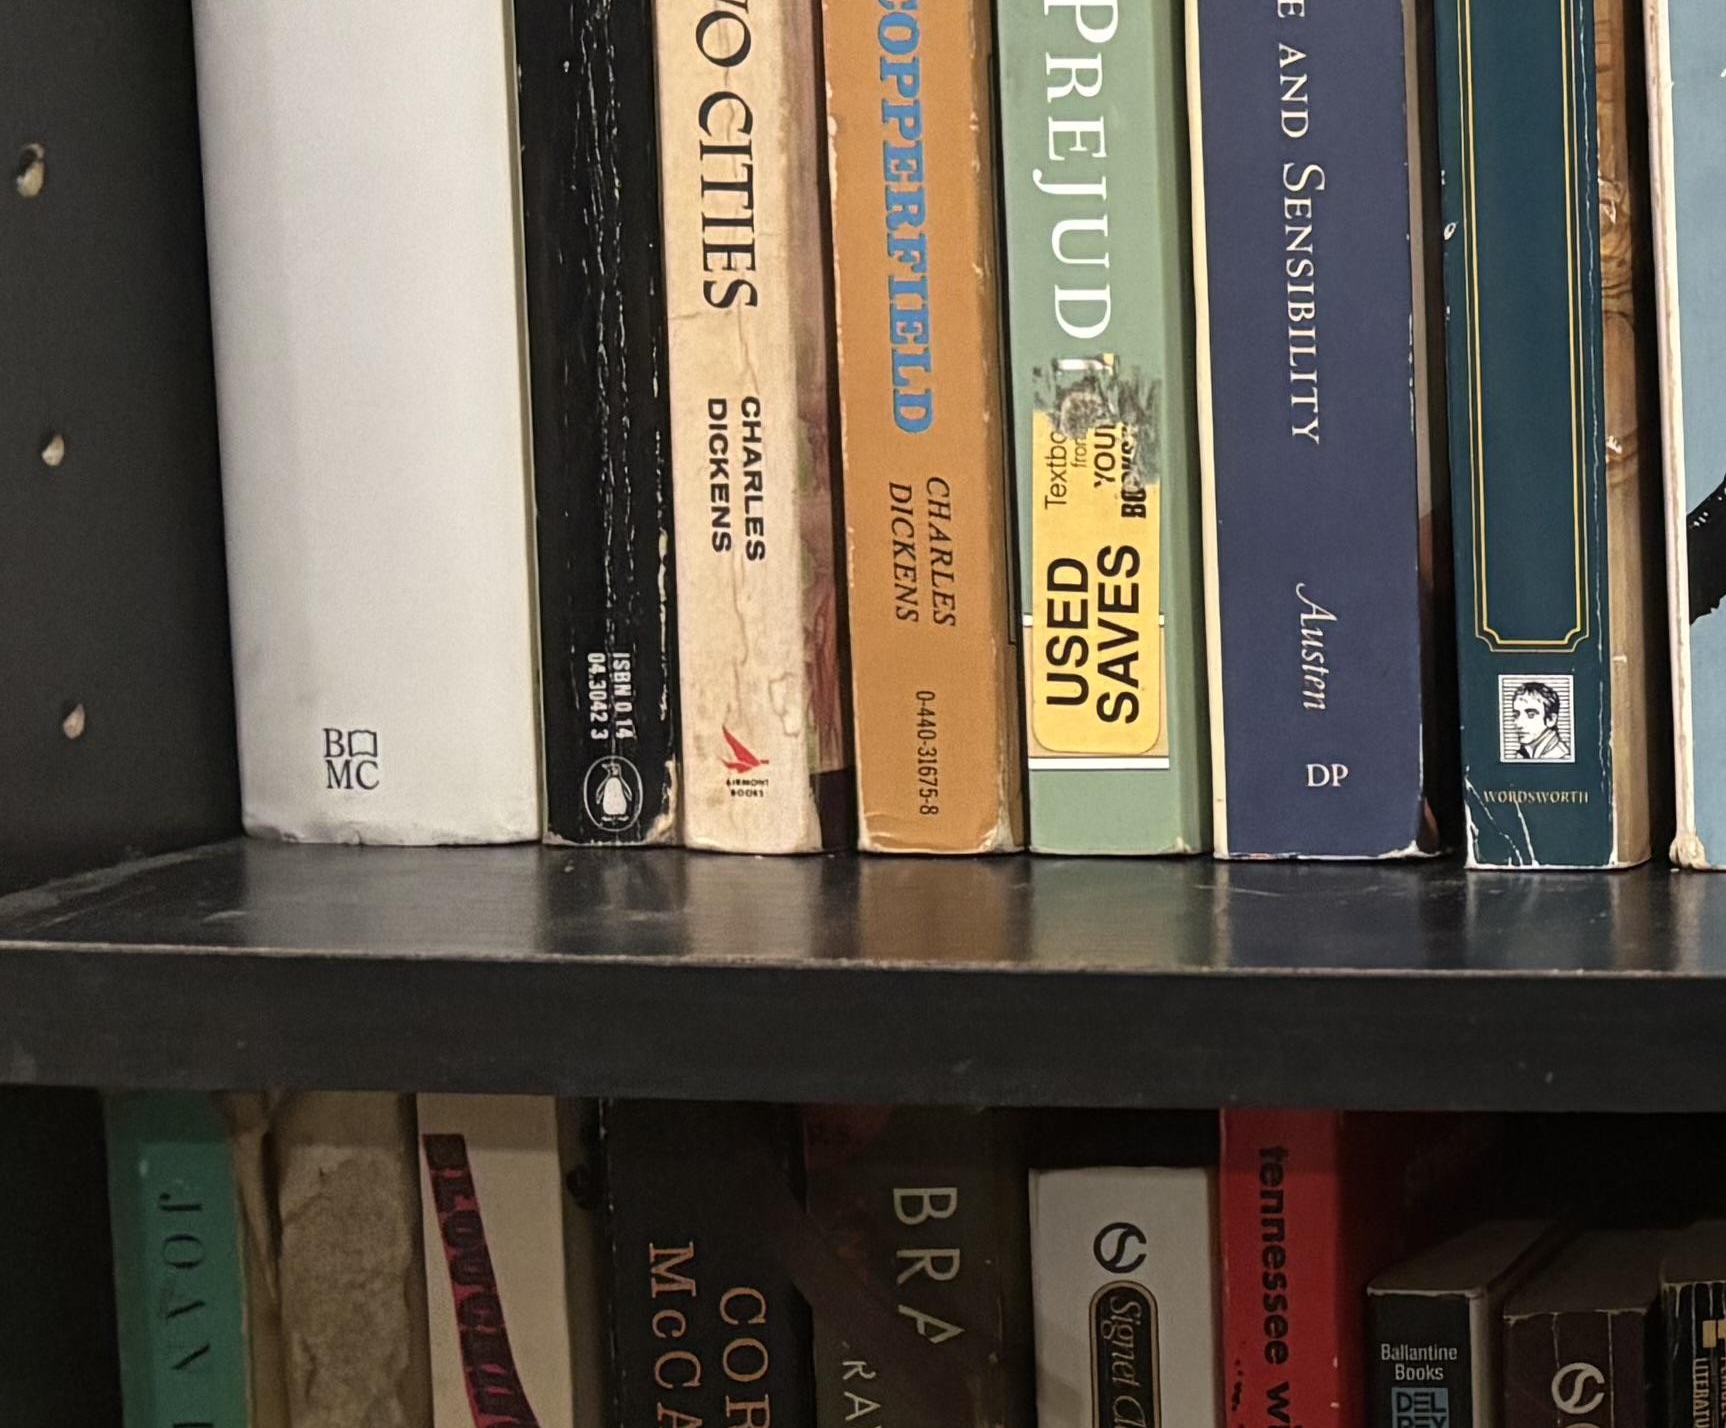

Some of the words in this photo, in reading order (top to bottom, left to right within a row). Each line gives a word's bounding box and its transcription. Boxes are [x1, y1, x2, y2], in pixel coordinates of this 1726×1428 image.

[1278, 42, 1309, 139] AND
[697, 90, 759, 309] CITIES
[1282, 162, 1326, 445] SENSIBILITY
[1045, 557, 1090, 707] USED
[1095, 544, 1141, 725] SAVES
[1295, 582, 1338, 710] Austen
[915, 690, 940, 816] 0-440-31675-8
[1306, 763, 1349, 788] DP
[1258, 1146, 1290, 1366] tennessee
